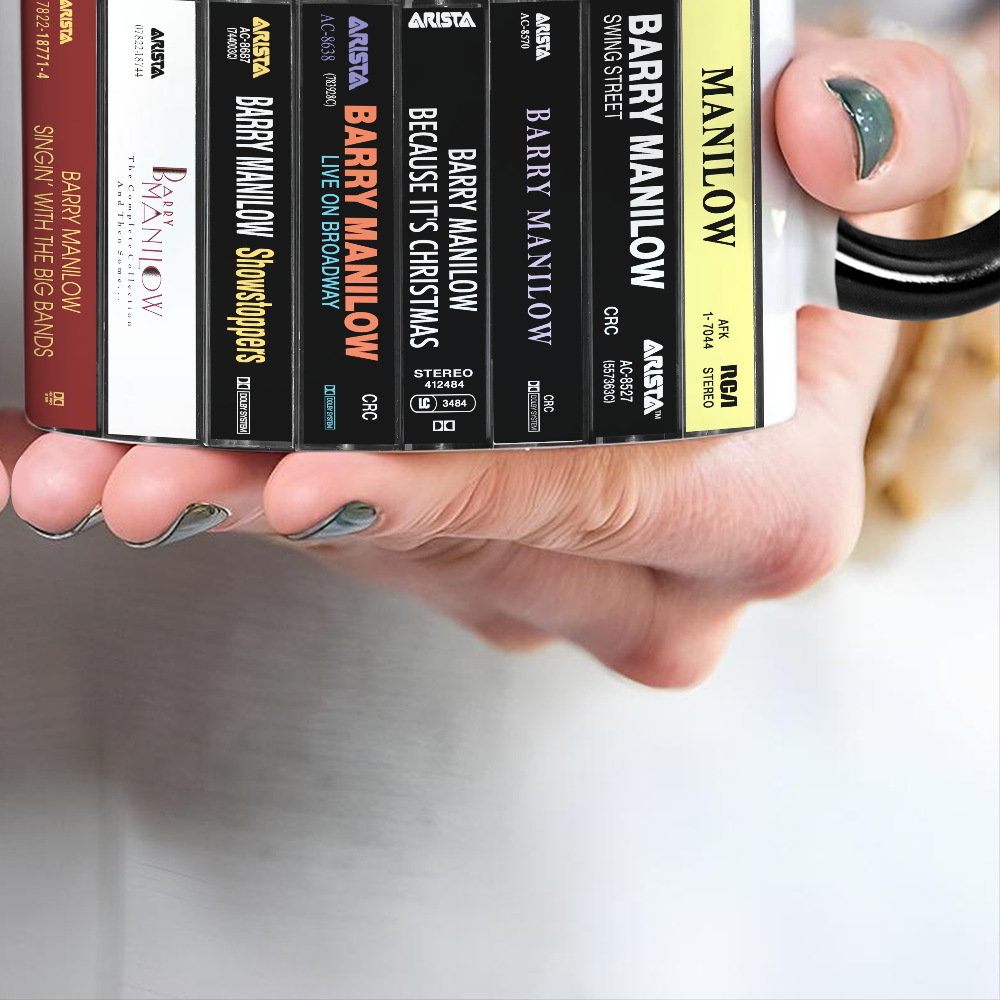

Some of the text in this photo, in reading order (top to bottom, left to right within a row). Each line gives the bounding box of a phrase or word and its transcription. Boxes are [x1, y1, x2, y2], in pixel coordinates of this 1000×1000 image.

[240, 27, 250, 63] AC-8687
[321, 14, 335, 61] AC-8638
[521, 13, 530, 49] AC-8570
[604, 15, 622, 120] SWING STREET
[629, 14, 665, 289] BARRY MANILOW
[702, 66, 735, 247] MANILOW
[34, 193, 53, 230] WITH
[227, 96, 274, 363] BARRY MANILOW Showstoppers
[321, 156, 340, 309] LIVE ON BROADWAY
[409, 108, 439, 348] BECAUSE IT'S CHRISTMAS
[527, 108, 552, 345] BARRY MANILOW
[34, 236, 53, 263] THE
[34, 269, 53, 296] BIG
[34, 301, 53, 357] BANDS
[414, 369, 473, 378] STEREO
[620, 360, 633, 402] AC-8527
[703, 368, 714, 408] STEREO
